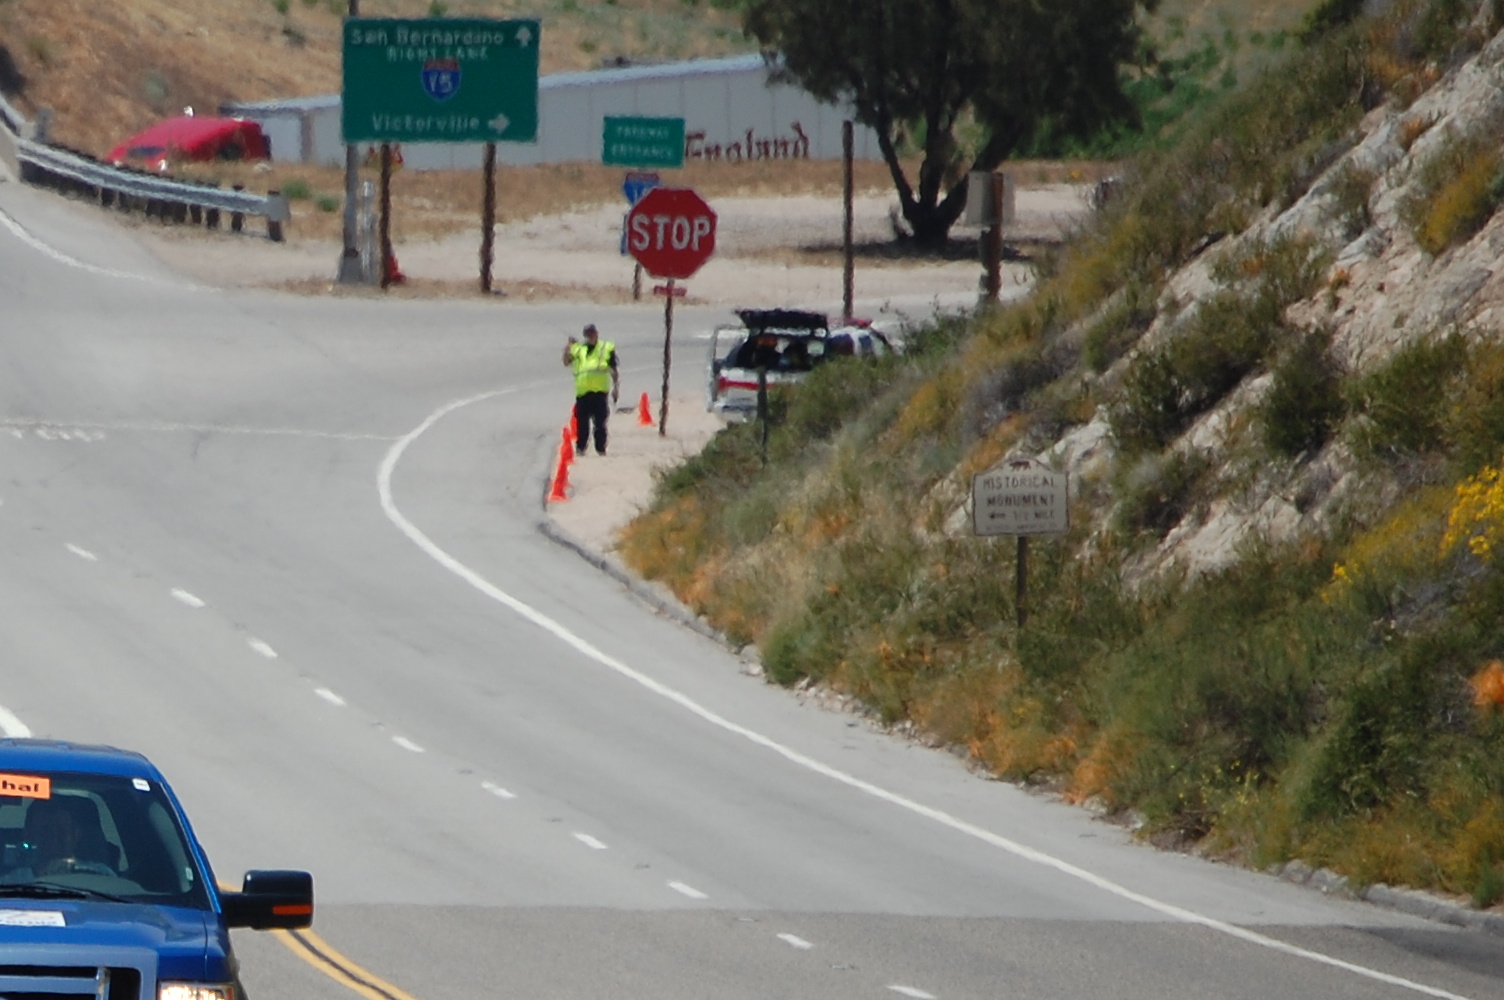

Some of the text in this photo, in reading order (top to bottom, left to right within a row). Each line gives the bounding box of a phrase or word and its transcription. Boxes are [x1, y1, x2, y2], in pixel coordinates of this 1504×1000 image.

[351, 26, 504, 45] San Bernardino
[428, 71, 454, 93] 15
[372, 112, 480, 132] Victorville
[632, 213, 711, 250] STOP
[983, 476, 1055, 490] HISTORICAL
[986, 494, 1055, 507] MONUMENT
